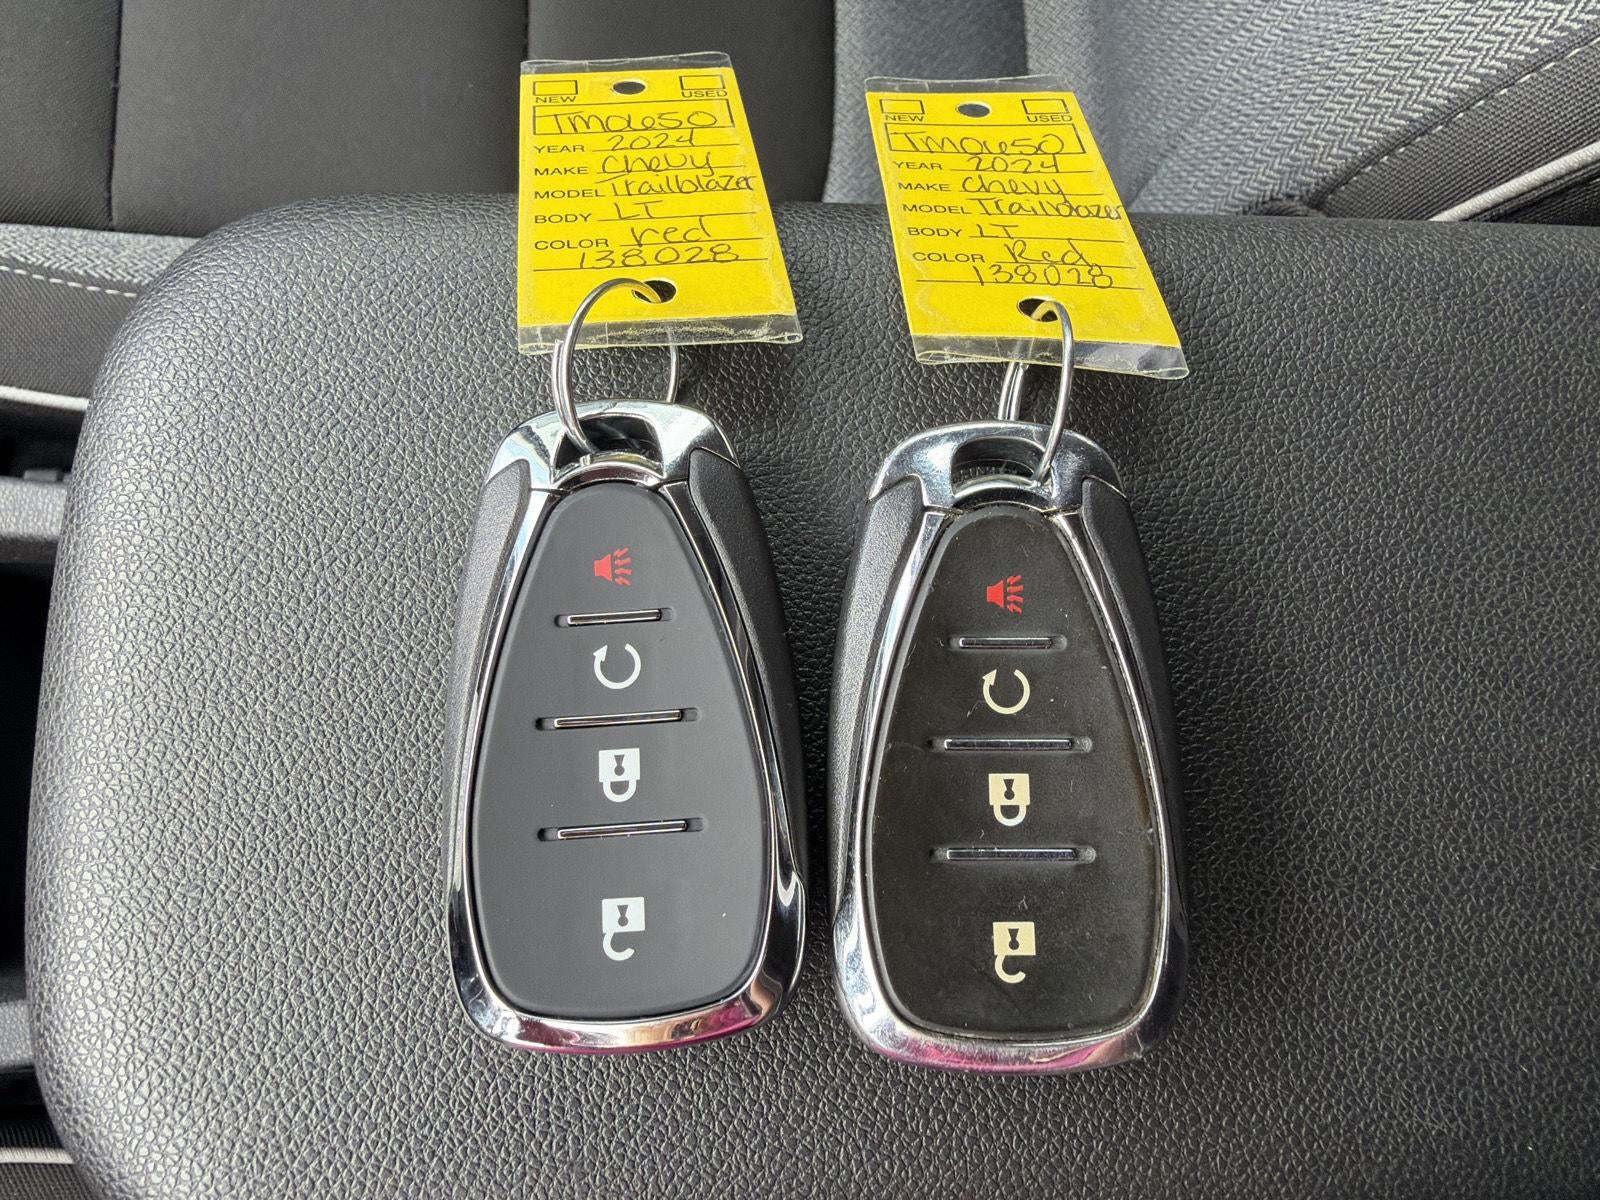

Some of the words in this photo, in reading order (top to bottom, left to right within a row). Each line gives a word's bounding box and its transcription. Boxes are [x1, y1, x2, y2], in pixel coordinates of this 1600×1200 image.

[535, 95, 577, 103] NEW
[681, 90, 728, 98] USED
[1027, 114, 1073, 122] USED
[534, 145, 584, 153] YEAR
[608, 128, 696, 151] 2024
[893, 161, 943, 170] YEAR
[966, 154, 1060, 173] 2024
[534, 167, 588, 176] MAKE
[898, 182, 951, 192] MAKE
[534, 189, 606, 199] MODEL
[534, 213, 592, 223] BODY
[614, 200, 663, 220] LT
[902, 203, 971, 214] MODEL
[907, 227, 963, 237] BODY
[976, 223, 1019, 239] LT
[534, 239, 609, 250] COLOR
[579, 244, 739, 269] 138028
[912, 252, 986, 263] COLOR
[1004, 238, 1092, 267] Red
[972, 263, 1113, 289] 138028
